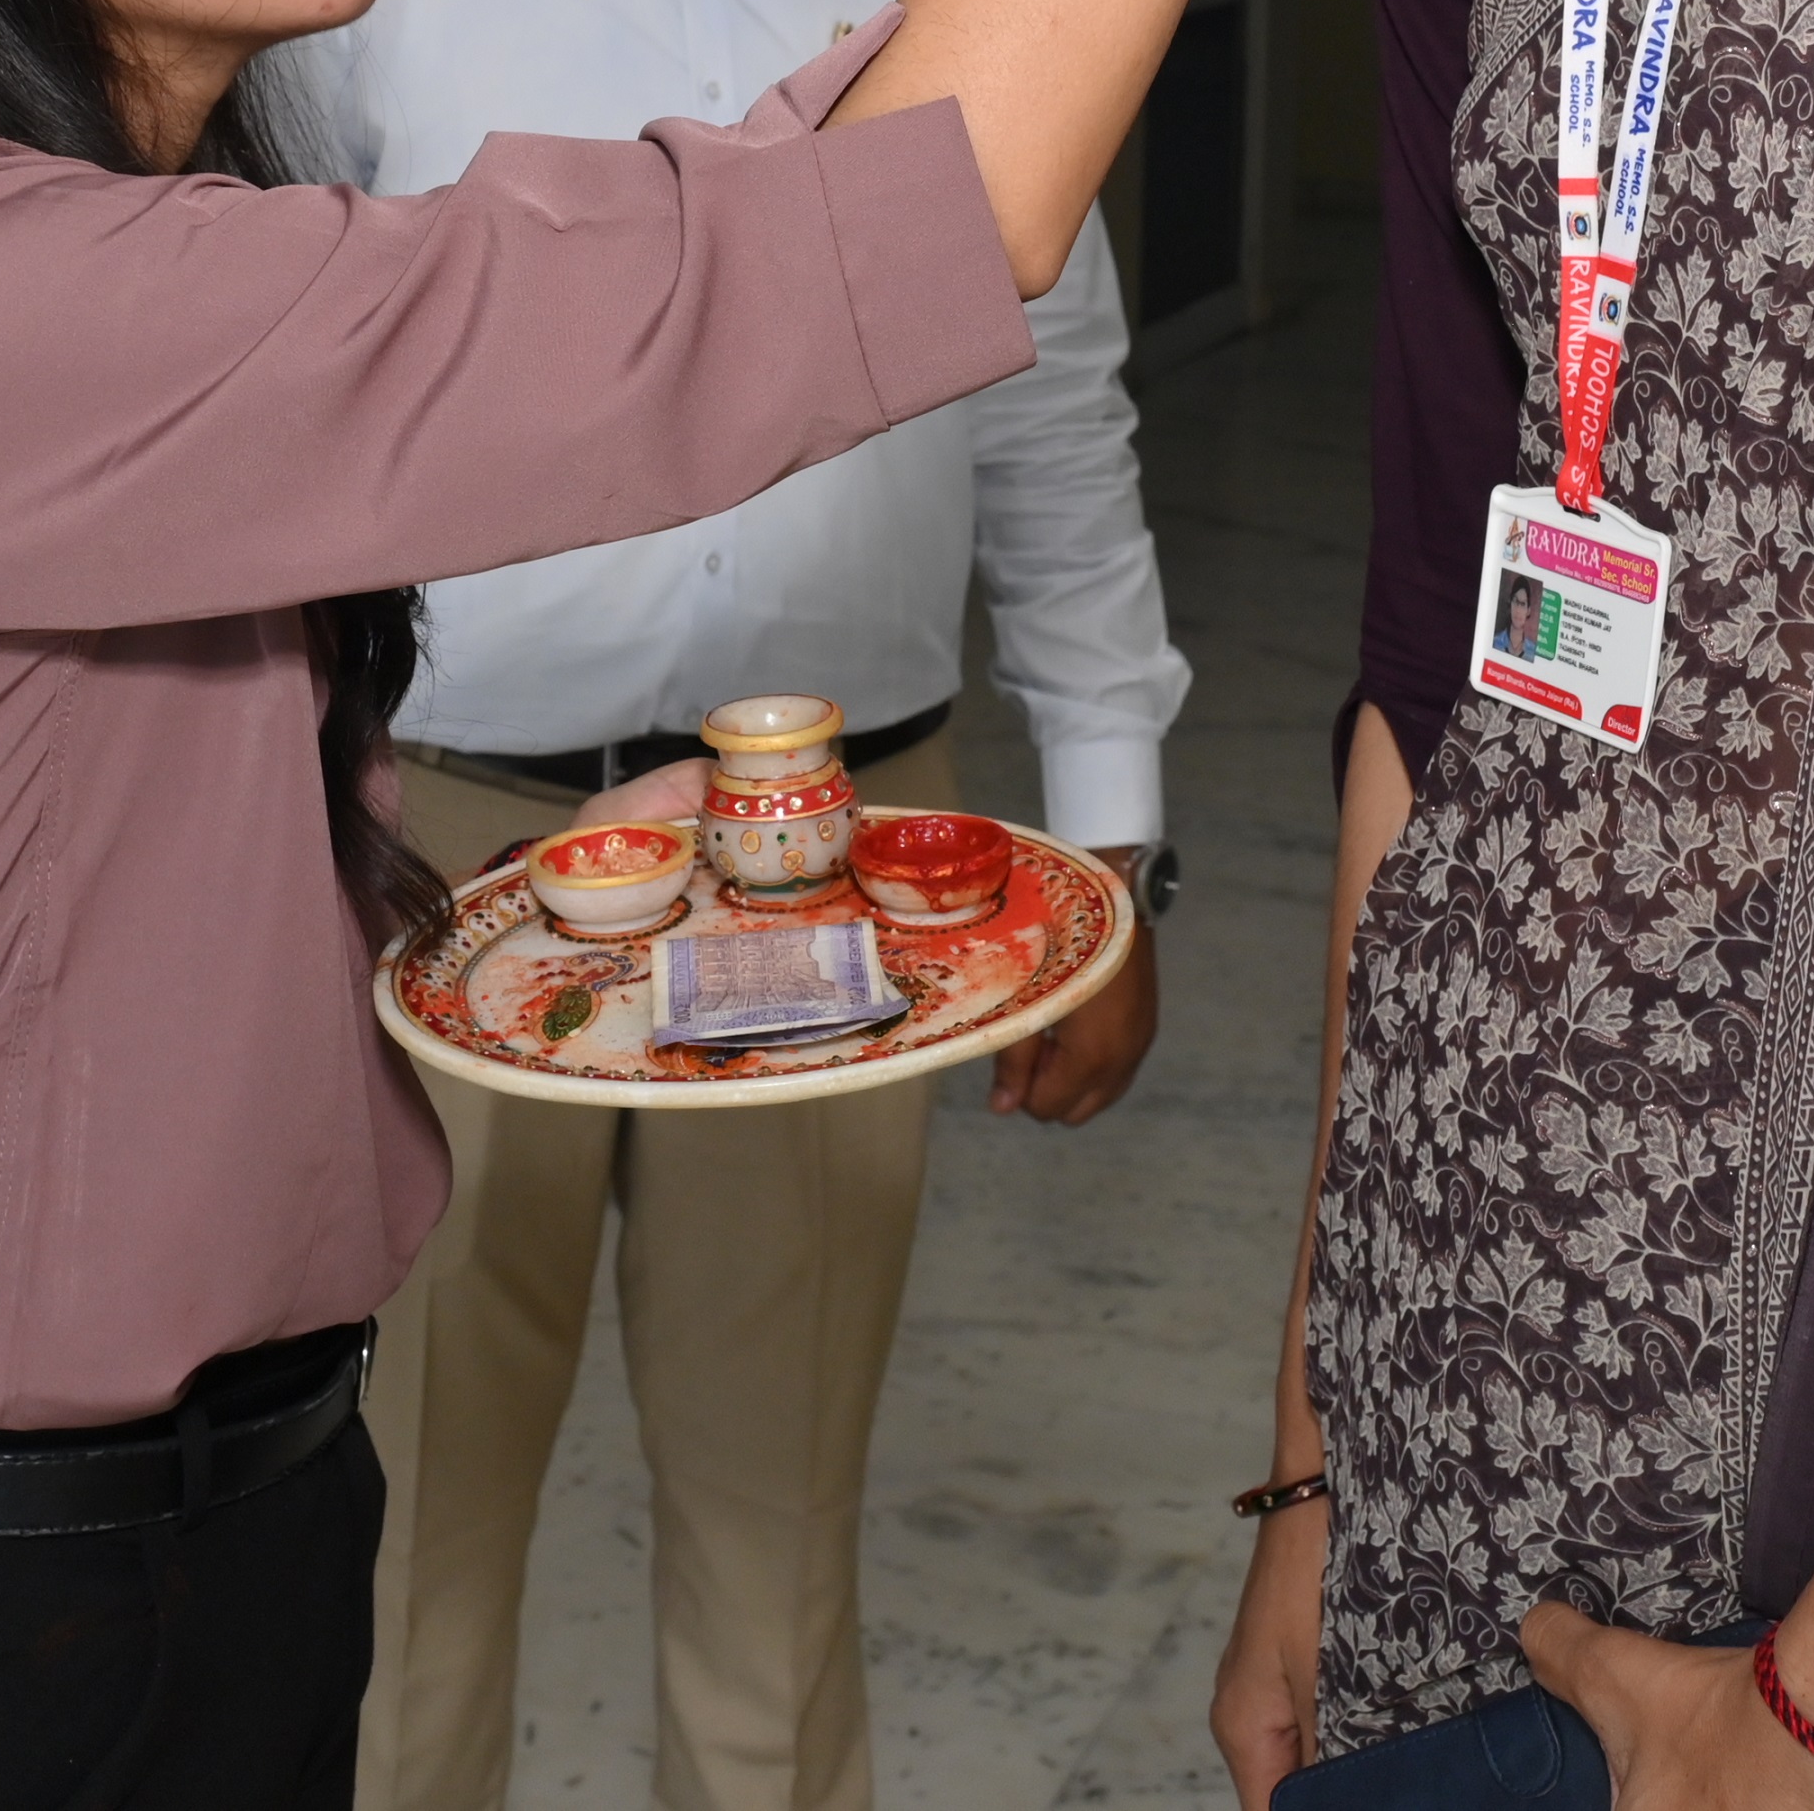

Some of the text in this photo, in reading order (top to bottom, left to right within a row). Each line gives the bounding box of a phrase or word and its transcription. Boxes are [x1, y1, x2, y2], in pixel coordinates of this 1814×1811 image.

[1567, 73, 1581, 135] SCHOOL
[1581, 59, 1596, 148] MEMO. S.S.
[1613, 156, 1631, 218] SCHOOL
[1623, 147, 1647, 236] MEMO. S.S.
[1579, 345, 1614, 452] SCHOOL
[1527, 525, 1656, 579] RAVIDRA Memorial Sr.
[1600, 566, 1619, 583] Sec.
[1621, 573, 1653, 594] School
[1607, 716, 1637, 737] Director
